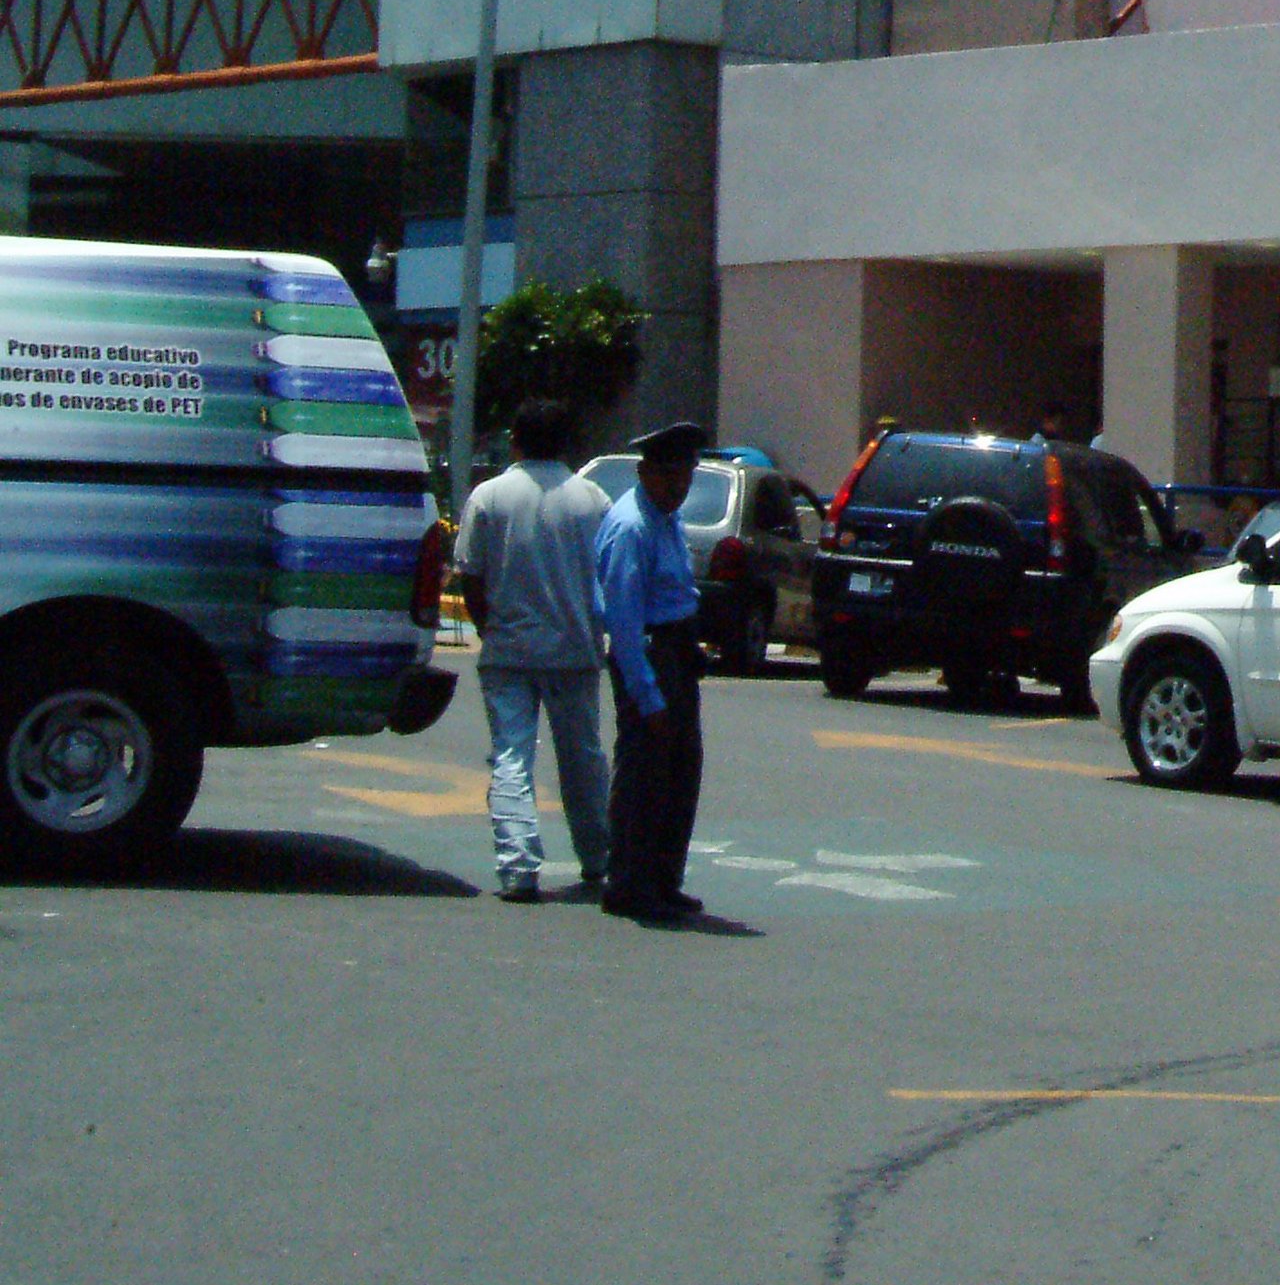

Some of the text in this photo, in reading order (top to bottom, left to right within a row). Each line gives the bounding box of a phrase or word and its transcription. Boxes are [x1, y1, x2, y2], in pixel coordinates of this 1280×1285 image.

[8, 339, 200, 365] Programa educativo
[81, 368, 104, 385] de
[109, 370, 173, 389] acopio
[177, 373, 201, 389] de
[0, 391, 202, 415] os de envases de PET
[931, 541, 1001, 558] HONDA
